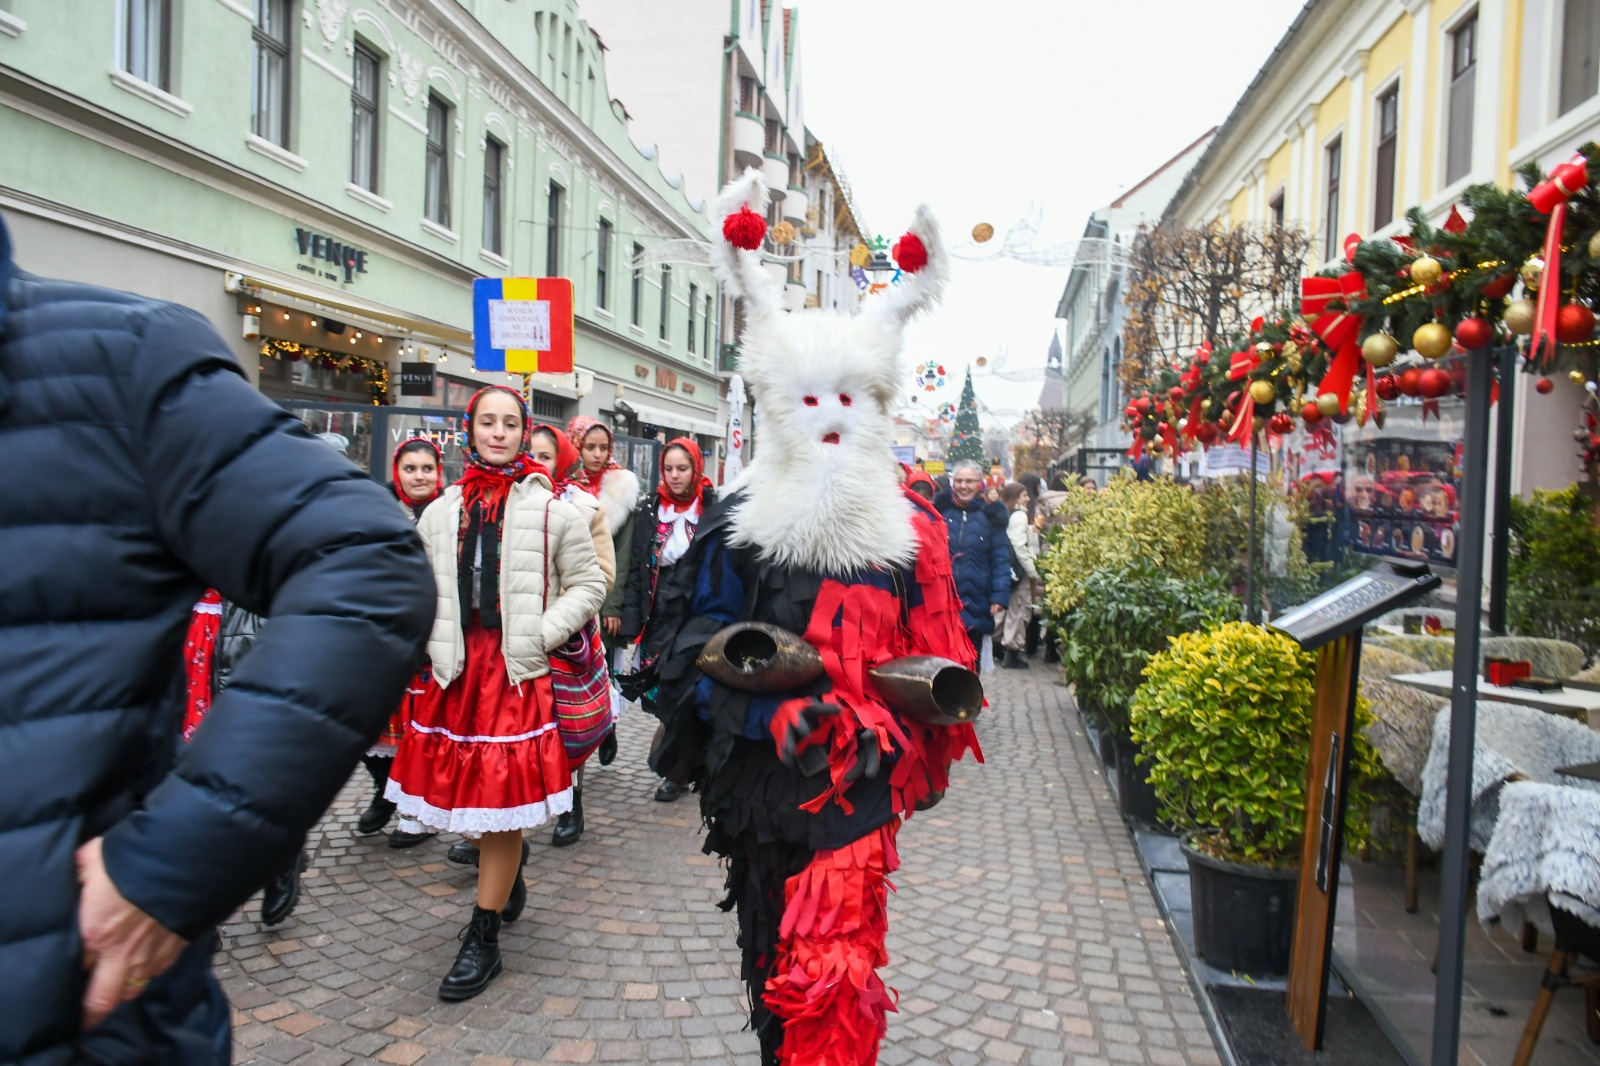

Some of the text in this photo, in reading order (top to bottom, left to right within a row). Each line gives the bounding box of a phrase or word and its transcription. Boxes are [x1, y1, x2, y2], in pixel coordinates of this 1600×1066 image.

[294, 228, 368, 284] VENUE
[403, 374, 432, 383] VENUE
[391, 428, 462, 453] VENUE
